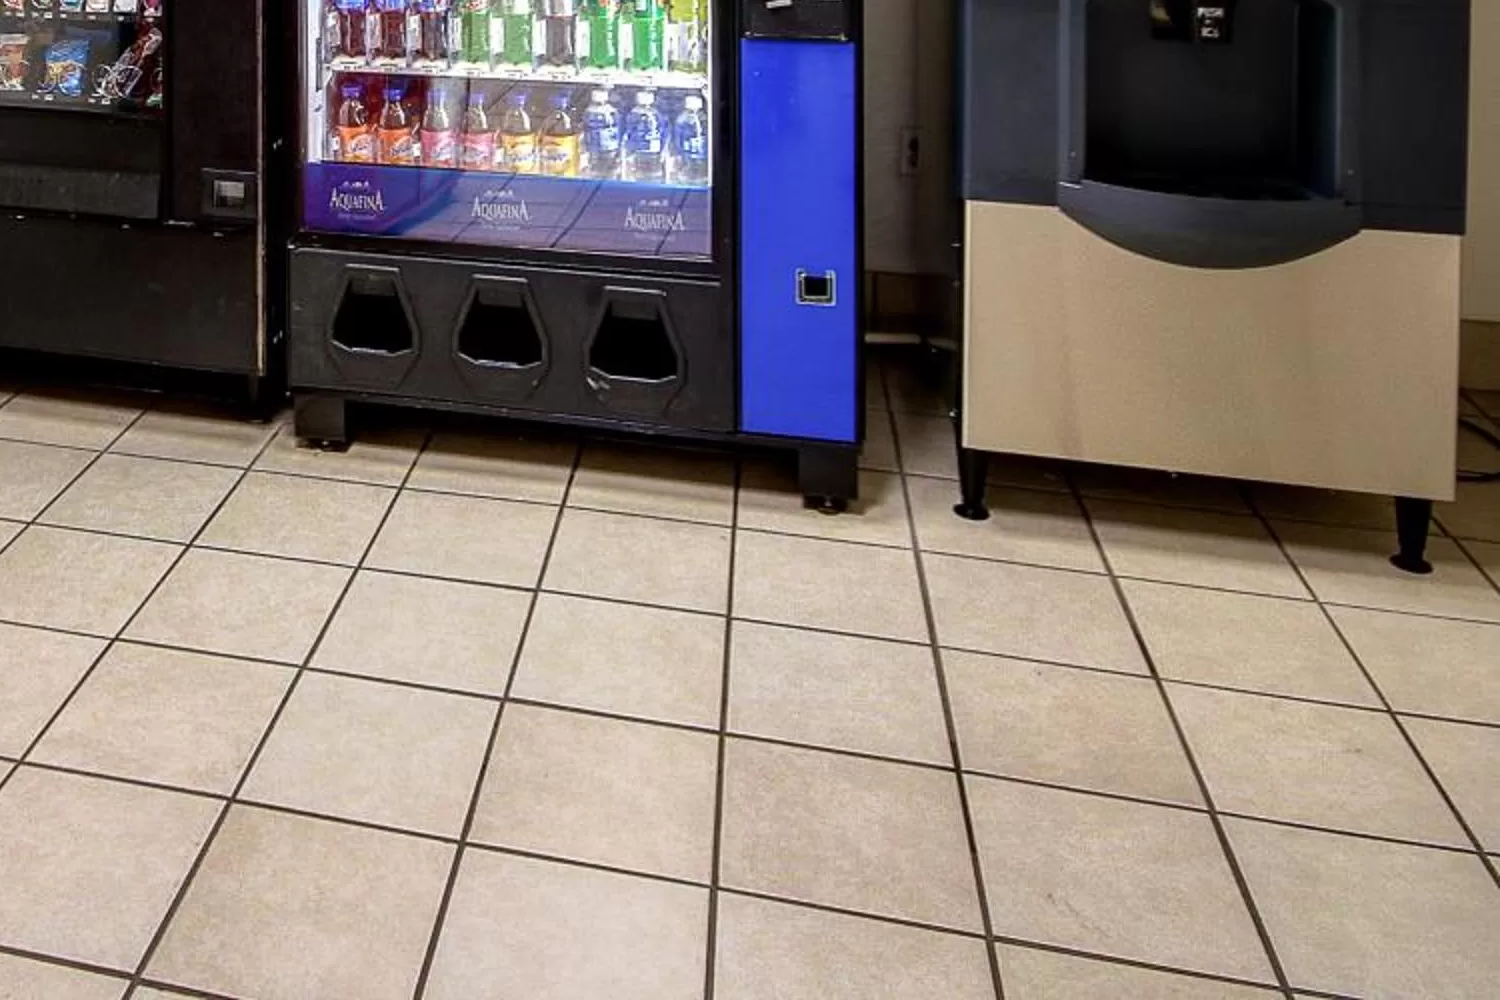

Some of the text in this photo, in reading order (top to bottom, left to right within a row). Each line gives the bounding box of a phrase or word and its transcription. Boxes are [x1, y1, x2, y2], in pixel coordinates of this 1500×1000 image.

[329, 187, 384, 212] AQUAFINA
[471, 196, 531, 221] AQUAFINA
[624, 206, 686, 232] AQUAFINA
